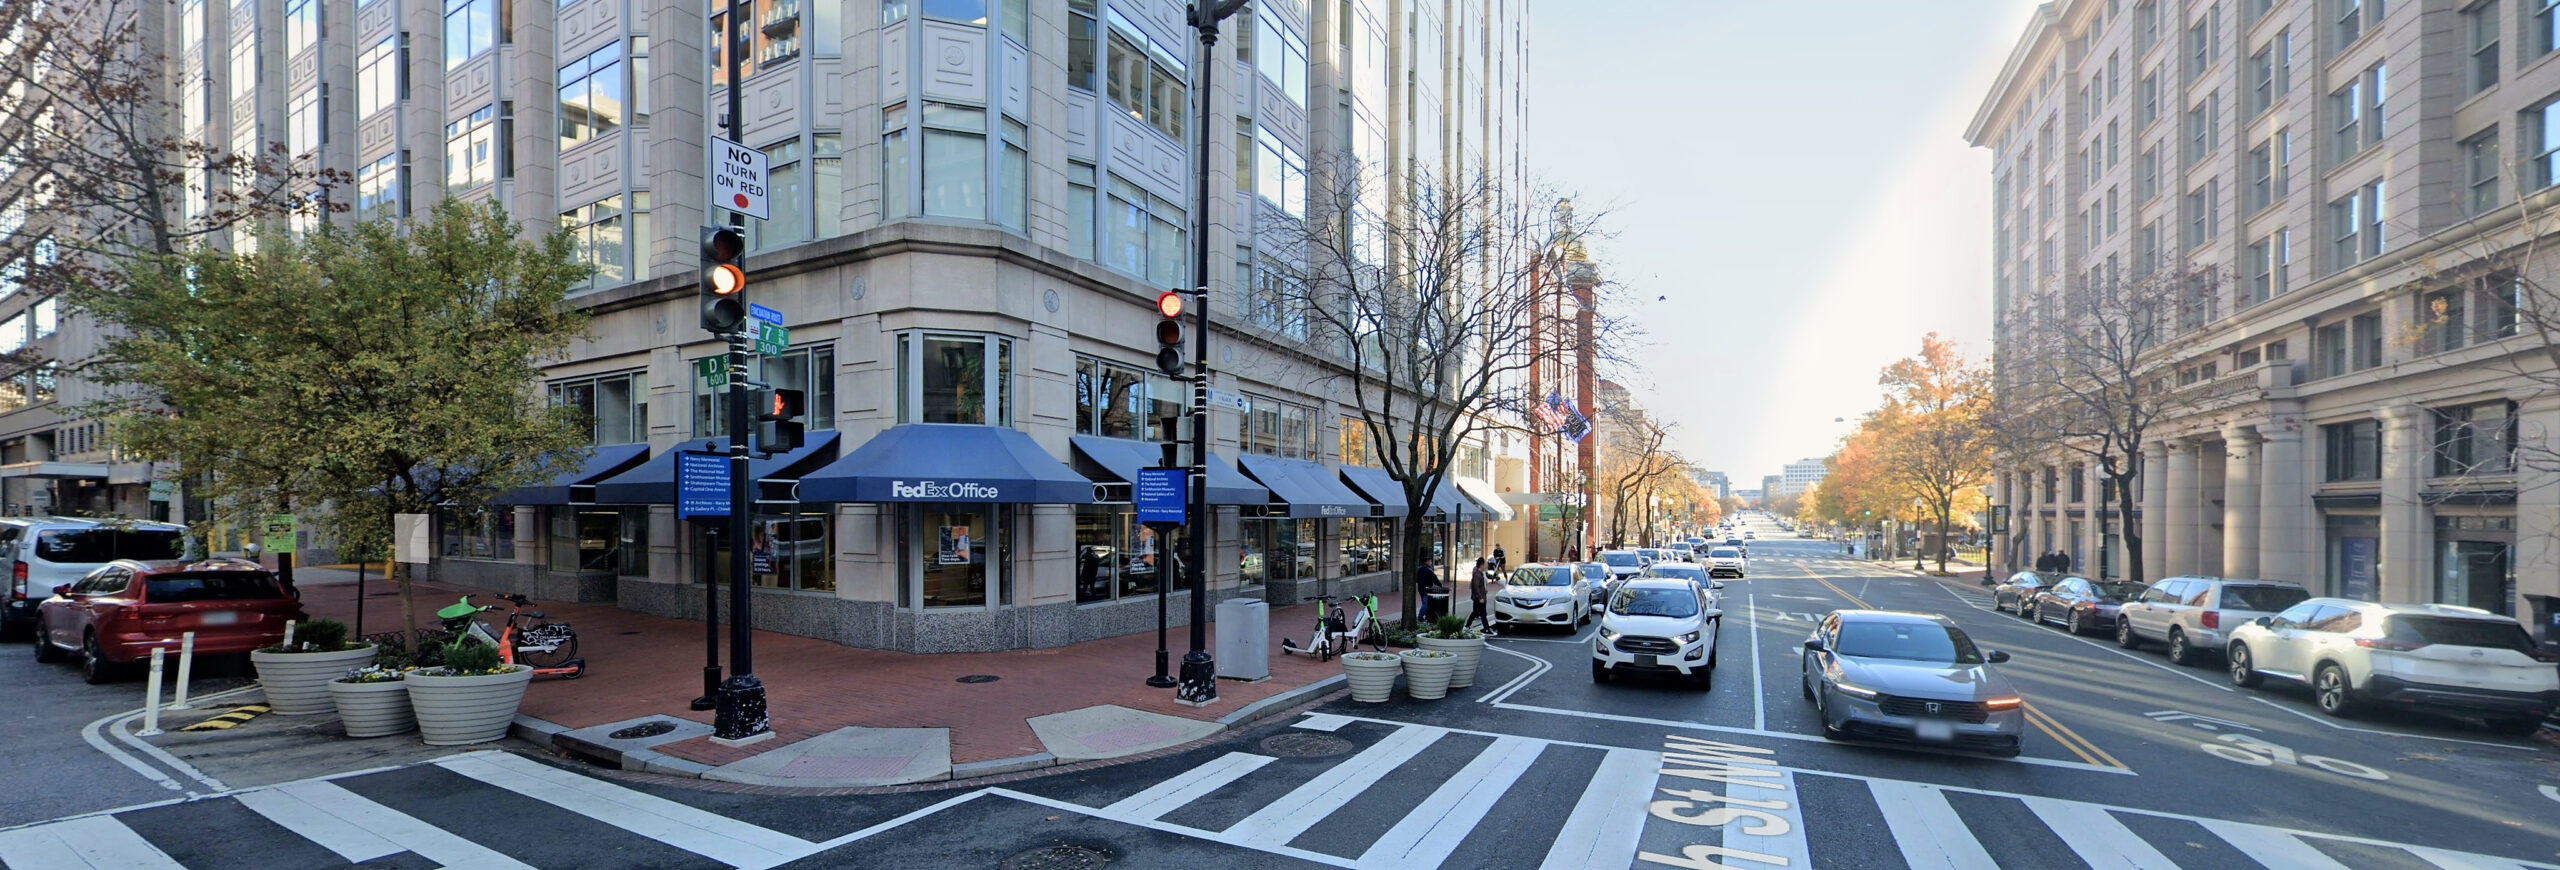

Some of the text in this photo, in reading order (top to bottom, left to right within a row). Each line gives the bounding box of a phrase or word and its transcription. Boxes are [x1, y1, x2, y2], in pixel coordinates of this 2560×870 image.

[728, 147, 752, 165] NO
[724, 162, 757, 182] TURN
[717, 175, 764, 197] ON RED
[763, 326, 772, 341] 7
[760, 341, 777, 355] 300
[709, 358, 718, 373] D
[710, 373, 724, 385] 600
